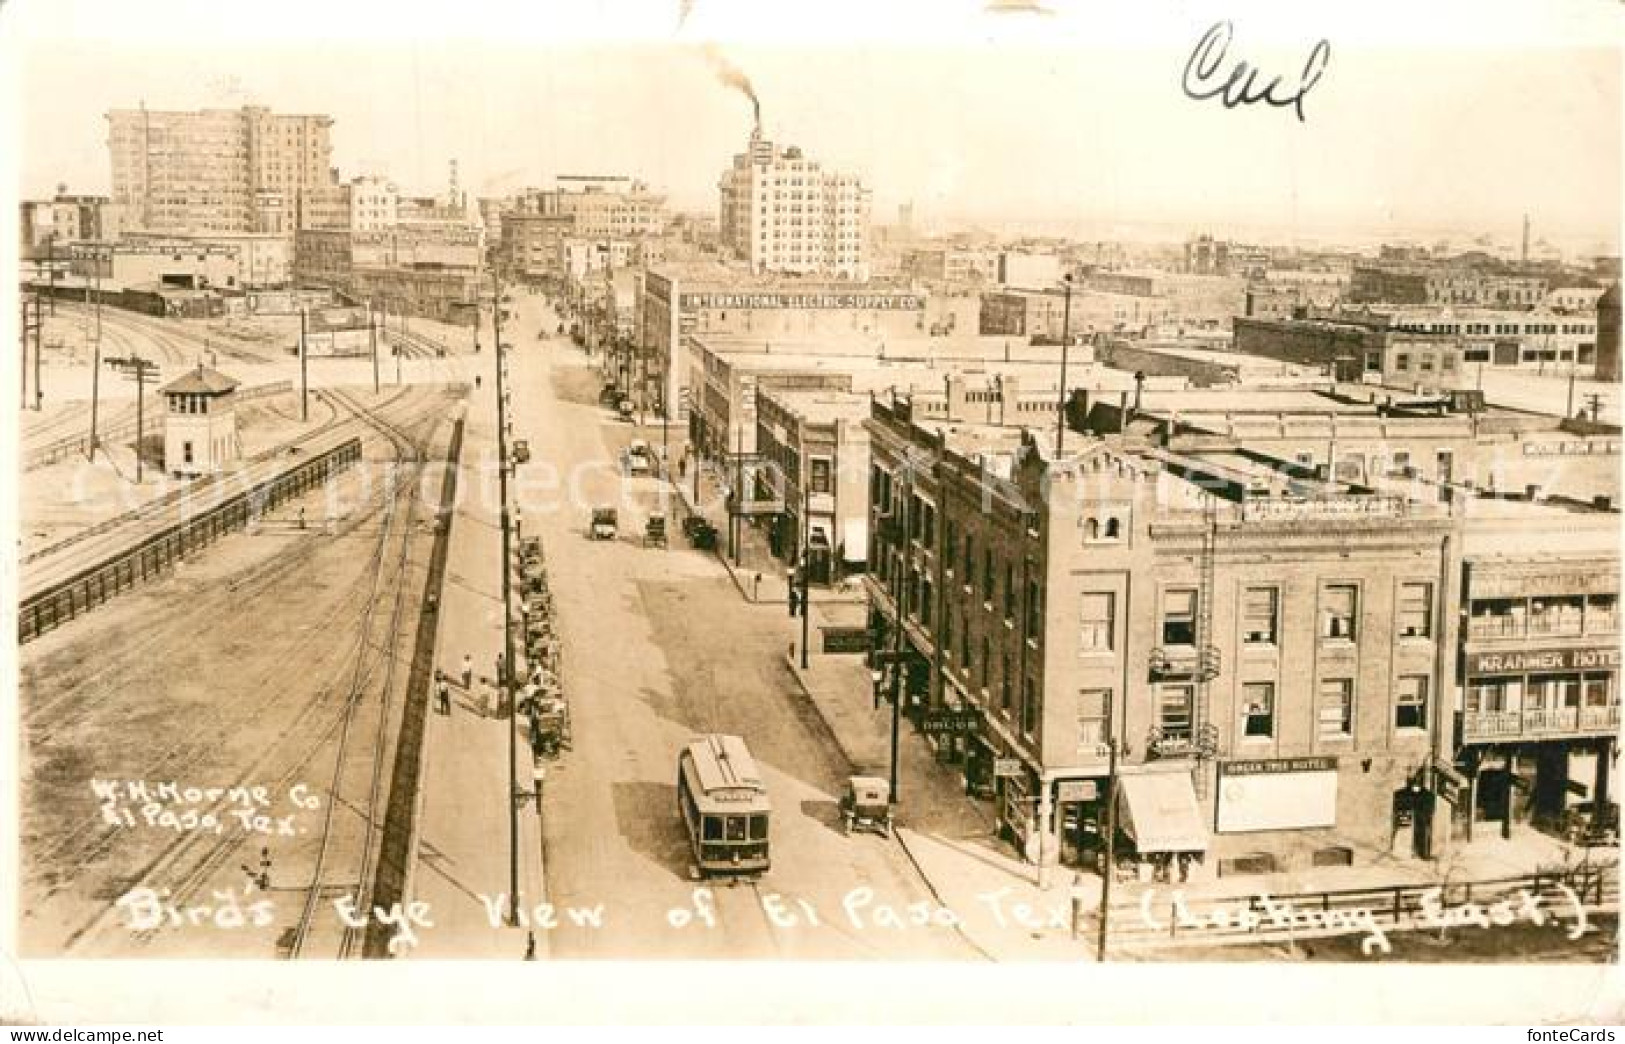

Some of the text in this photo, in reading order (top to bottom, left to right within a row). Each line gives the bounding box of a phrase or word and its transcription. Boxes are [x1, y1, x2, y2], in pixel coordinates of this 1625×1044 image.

[685, 294, 780, 307] INTERNATIONAL
[786, 294, 839, 307] ELECTRIC
[845, 294, 893, 307] SUPPLY
